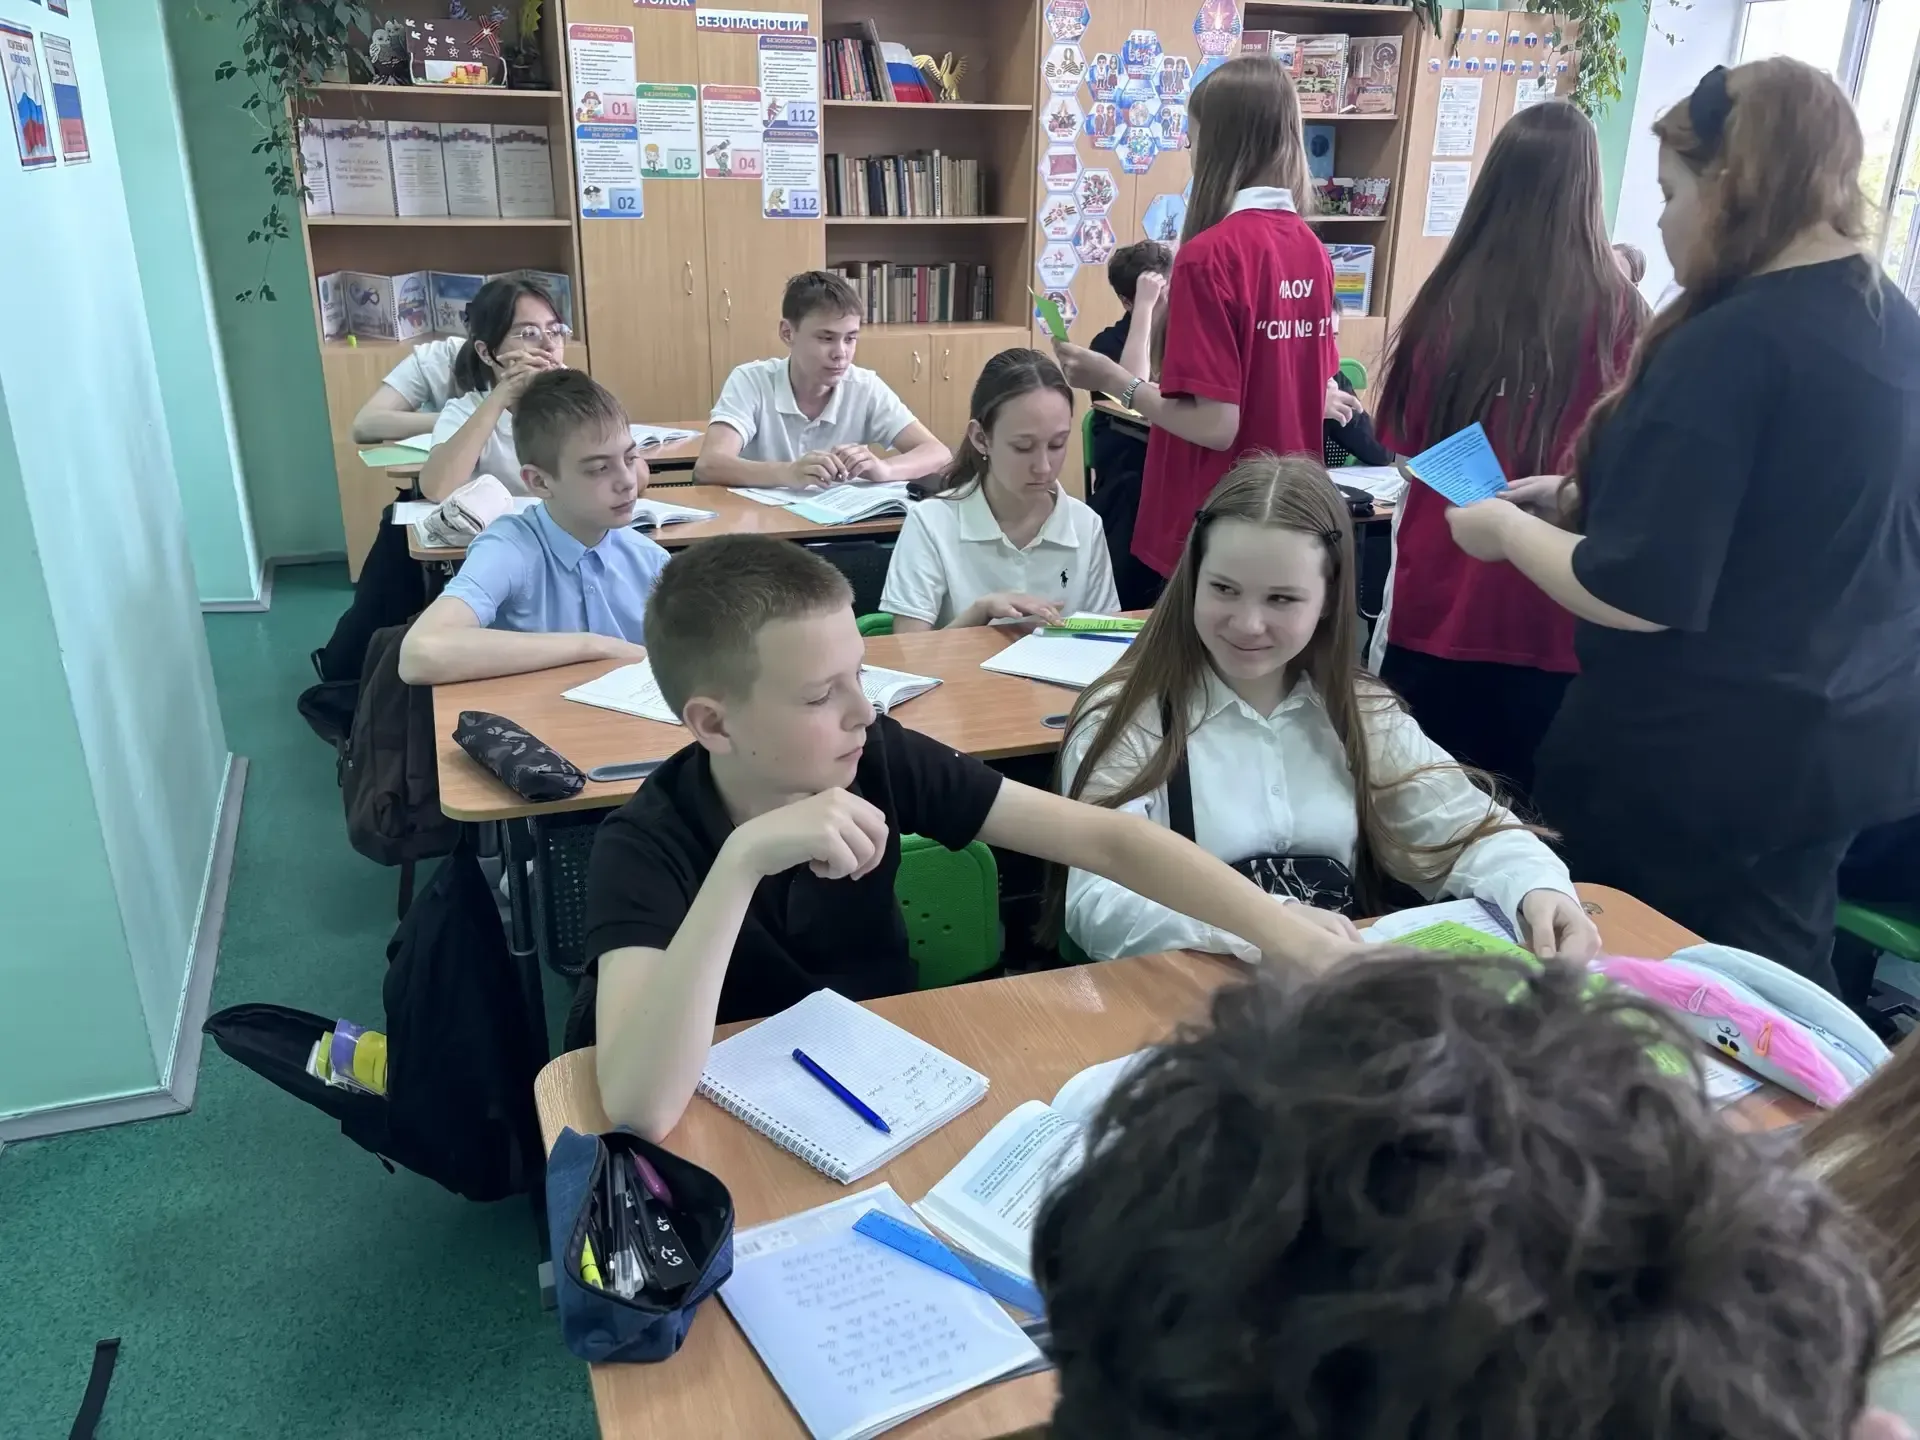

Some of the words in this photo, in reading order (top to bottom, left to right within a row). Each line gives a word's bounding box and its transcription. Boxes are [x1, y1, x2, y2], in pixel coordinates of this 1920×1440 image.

[696, 15, 802, 32] БЕЗОПАСНОСТИ
[612, 101, 630, 116] 01
[791, 109, 816, 123] 112
[674, 157, 692, 170] 03
[739, 157, 756, 170] 04
[617, 196, 636, 210] 02
[793, 197, 817, 210] 112
